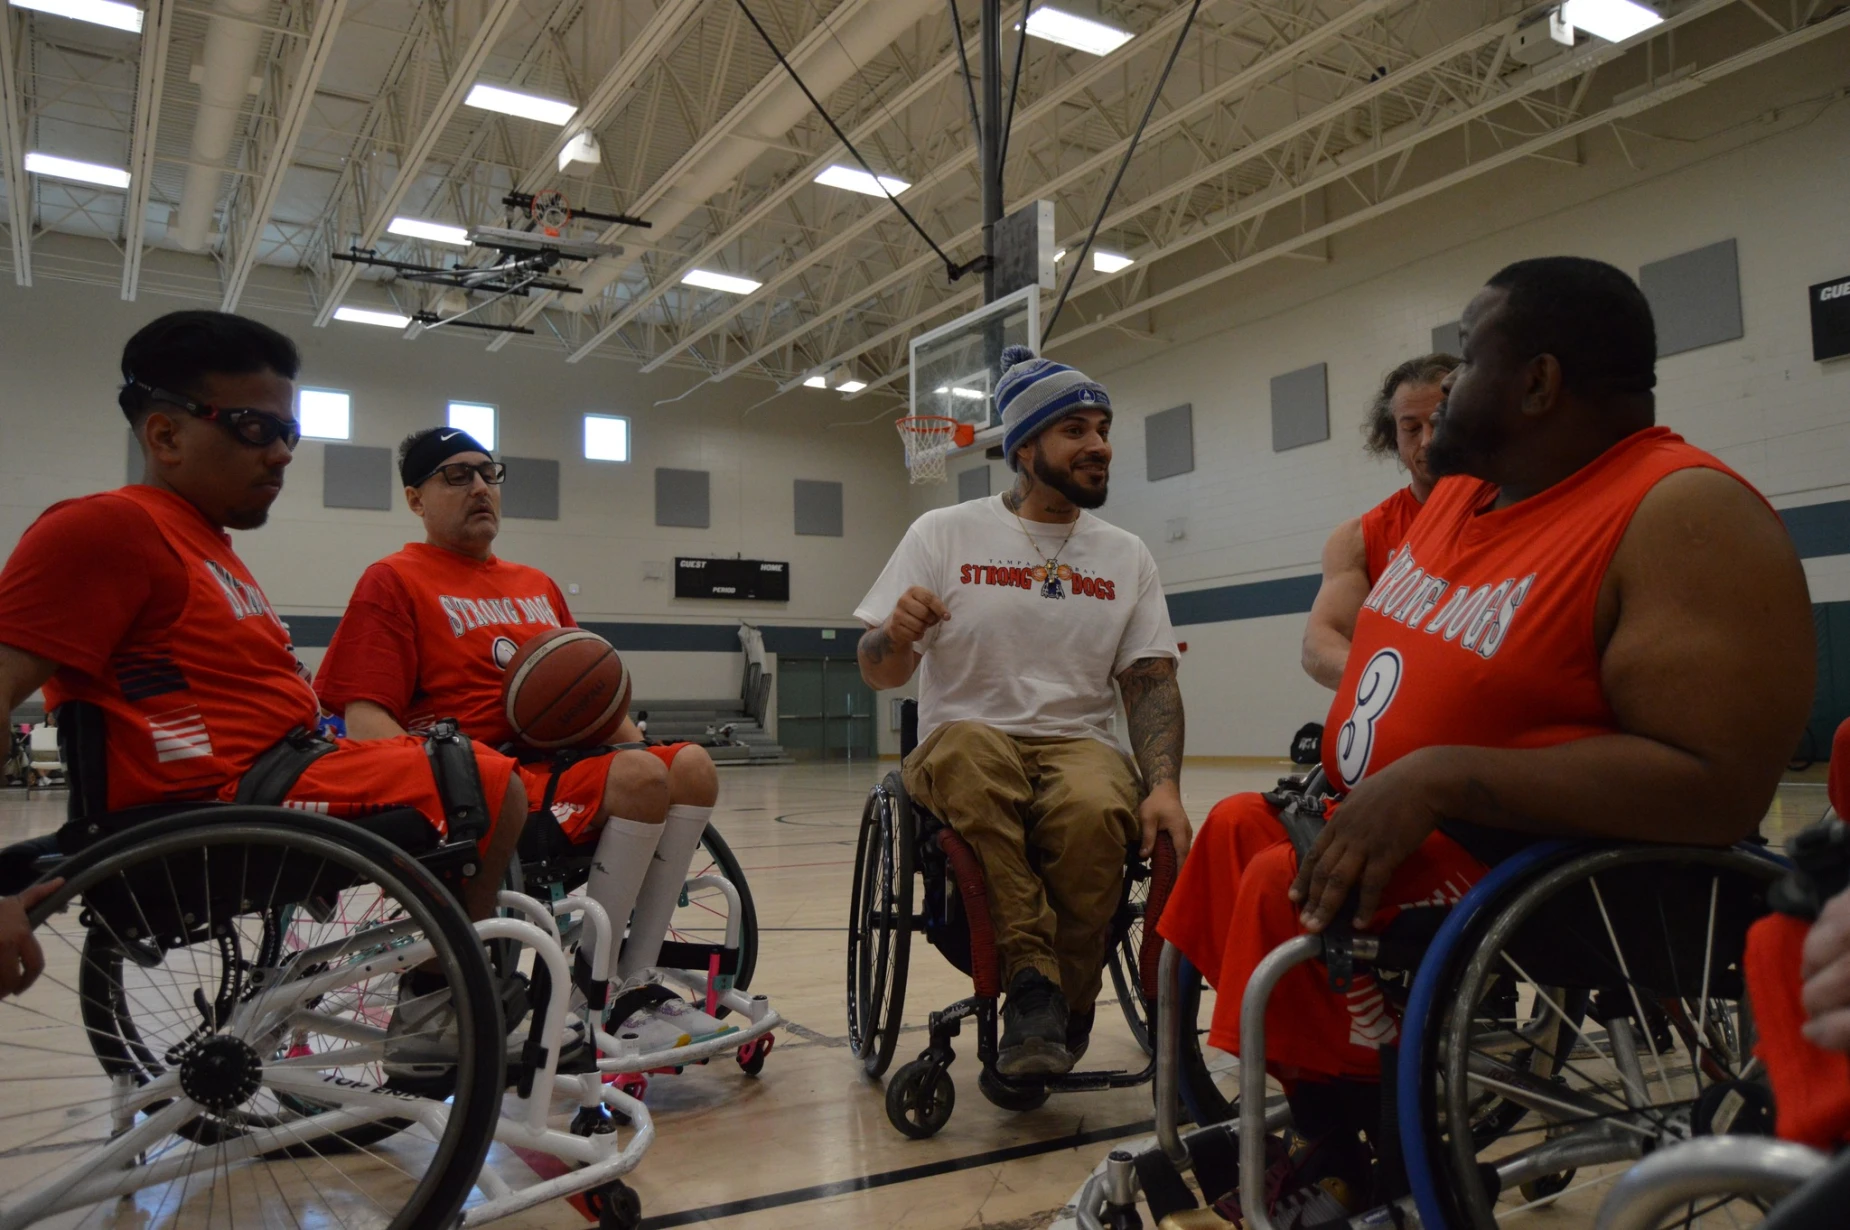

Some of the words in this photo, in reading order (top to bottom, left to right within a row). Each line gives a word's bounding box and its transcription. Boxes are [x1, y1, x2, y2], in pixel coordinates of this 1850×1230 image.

[680, 560, 707, 569] GUEST
[760, 563, 784, 572] HOME
[989, 558, 1031, 567] TAMPA
[1074, 567, 1097, 576] BAY
[712, 586, 736, 594] PERIOD
[960, 563, 1033, 590] STRONG
[1071, 572, 1116, 600] DOGS
[438, 594, 522, 638] STRONG
[1425, 571, 1537, 659] DOGS
